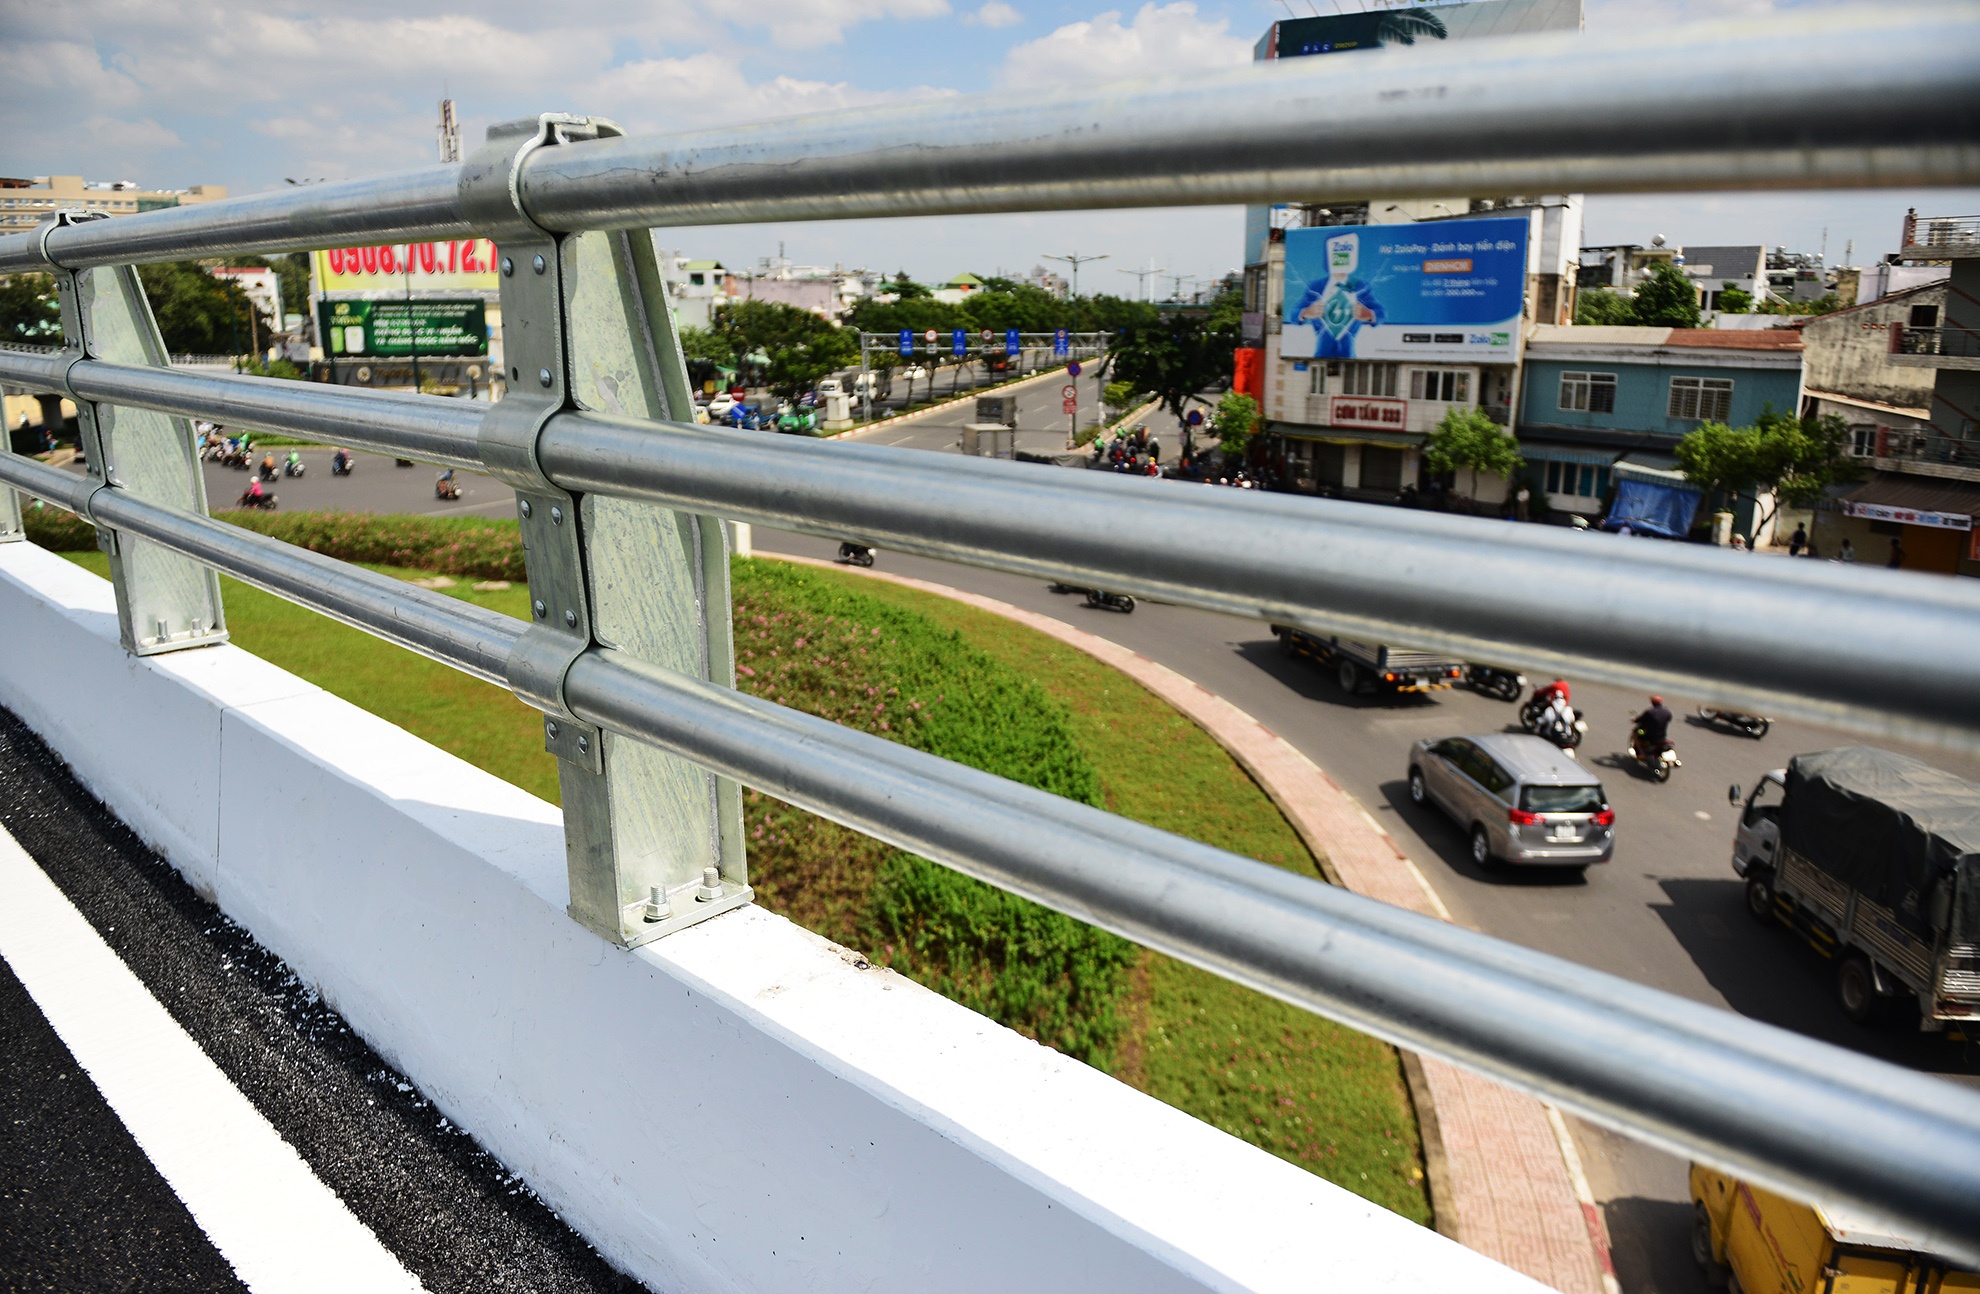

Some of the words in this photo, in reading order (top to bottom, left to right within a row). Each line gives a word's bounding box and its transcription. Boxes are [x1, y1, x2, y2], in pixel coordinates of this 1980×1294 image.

[1333, 241, 1354, 251] Zalo
[1394, 243, 1427, 254] ZaloPay
[1457, 241, 1474, 252] bay
[1470, 332, 1509, 345] ZaloPay
